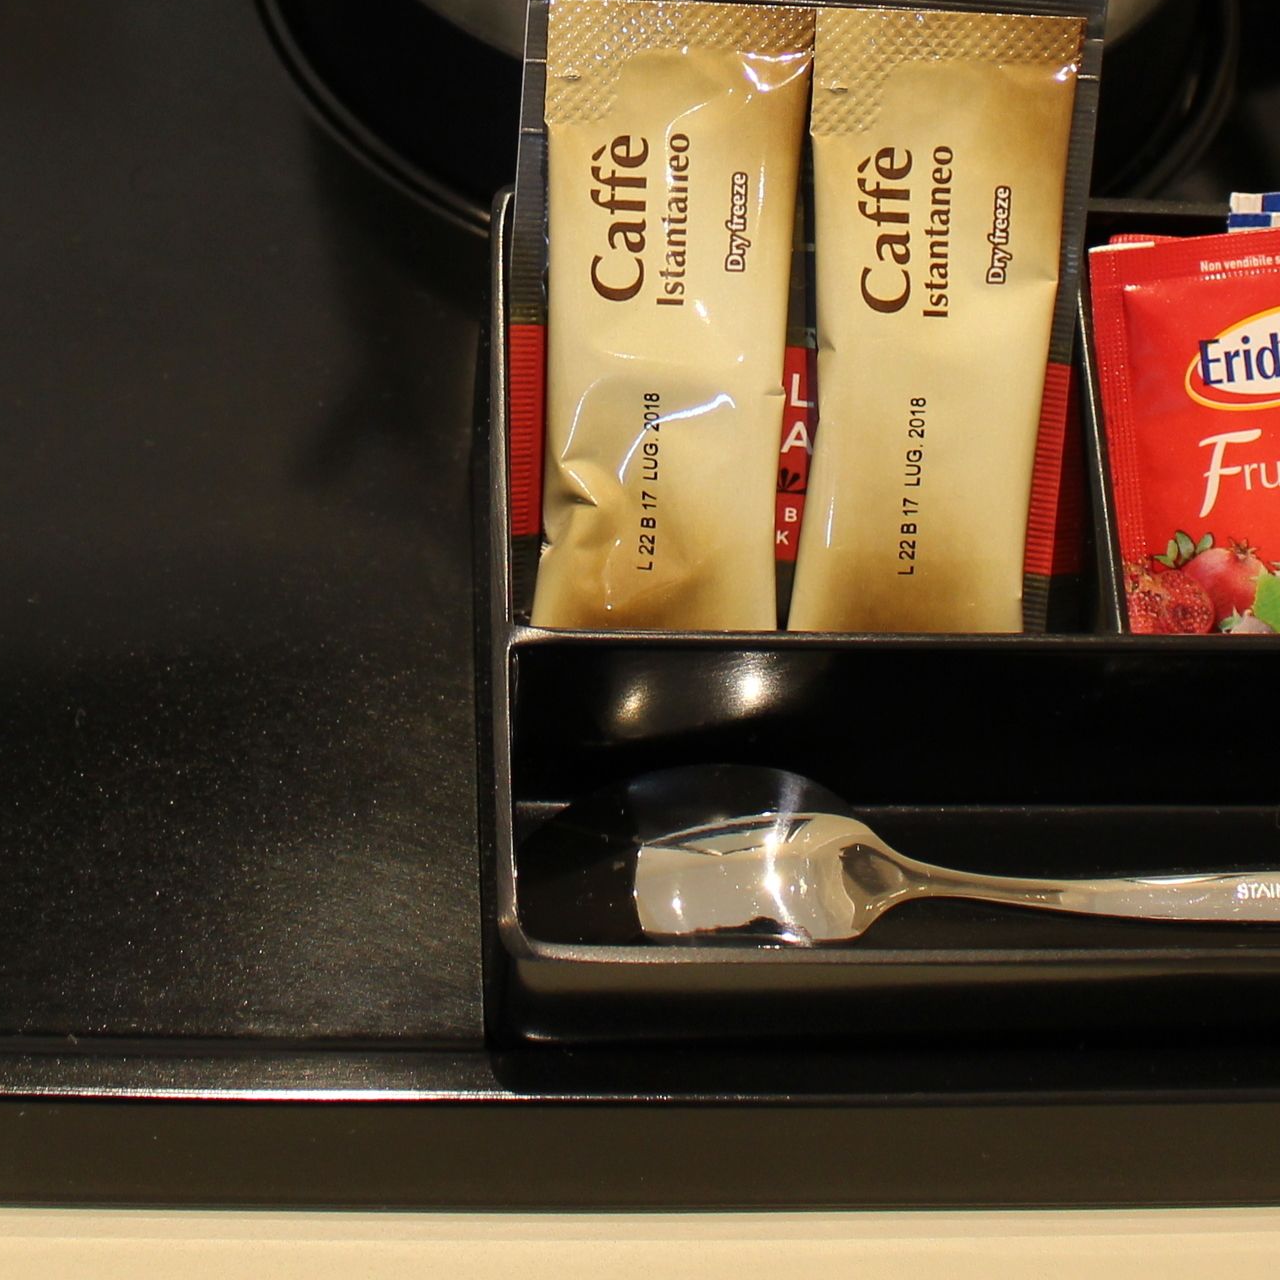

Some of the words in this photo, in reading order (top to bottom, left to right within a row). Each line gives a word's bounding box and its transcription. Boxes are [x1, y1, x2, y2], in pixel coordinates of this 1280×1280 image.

[590, 135, 650, 302] Caffè
[656, 133, 690, 306] Istantaneo
[725, 171, 748, 232] freeze
[987, 185, 1012, 245] freeze
[857, 147, 913, 314] Caffè
[922, 145, 954, 318] Istantaneo
[725, 232, 751, 273] Dry
[986, 245, 1013, 285] Dry
[1199, 259, 1222, 273] Non
[1224, 254, 1273, 270] vendibile
[644, 392, 661, 432] 2018
[908, 397, 927, 439] 2018
[643, 438, 659, 481] LUG.
[904, 444, 923, 487] LUG.
[642, 491, 657, 510] 17
[902, 497, 919, 516] 17
[640, 517, 657, 529] B
[901, 523, 917, 535] B
[639, 534, 656, 556] 22
[899, 540, 916, 560] 22
[637, 561, 653, 571] L
[897, 566, 914, 576] L
